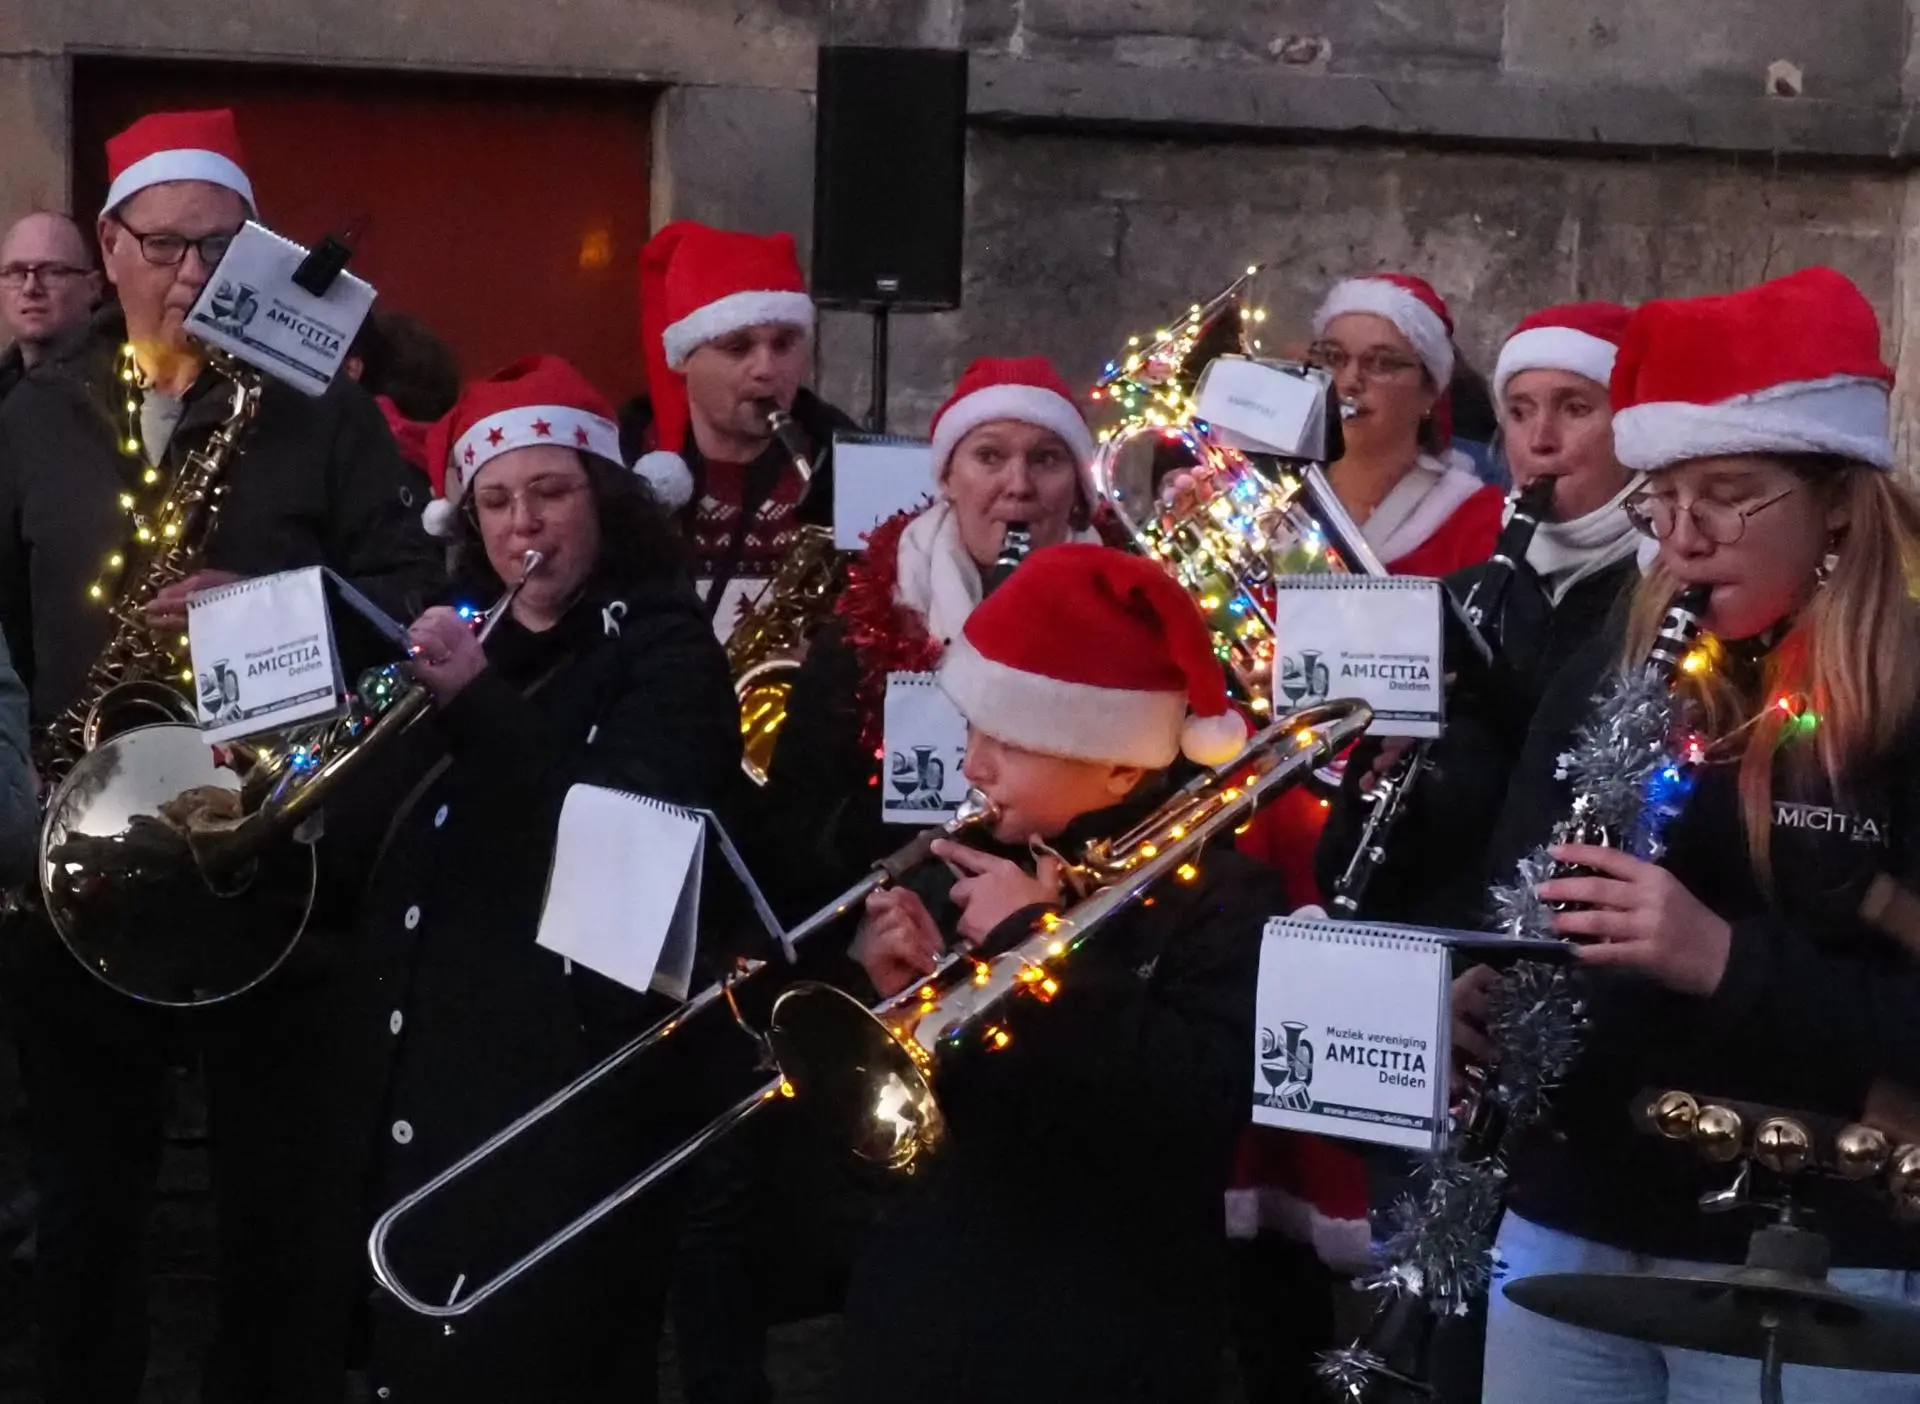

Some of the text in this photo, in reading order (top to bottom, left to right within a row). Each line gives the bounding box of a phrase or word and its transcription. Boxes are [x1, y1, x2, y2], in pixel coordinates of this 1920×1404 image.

[266, 308, 341, 352] AMICITIA
[247, 645, 321, 677] AMICITIA
[1340, 663, 1430, 680] AMICITIA
[1389, 681, 1431, 691] Delden
[1326, 1026, 1427, 1050] Muziek vereniging
[1325, 1043, 1427, 1074] AMICITIA
[1378, 1070, 1427, 1089] Delden
